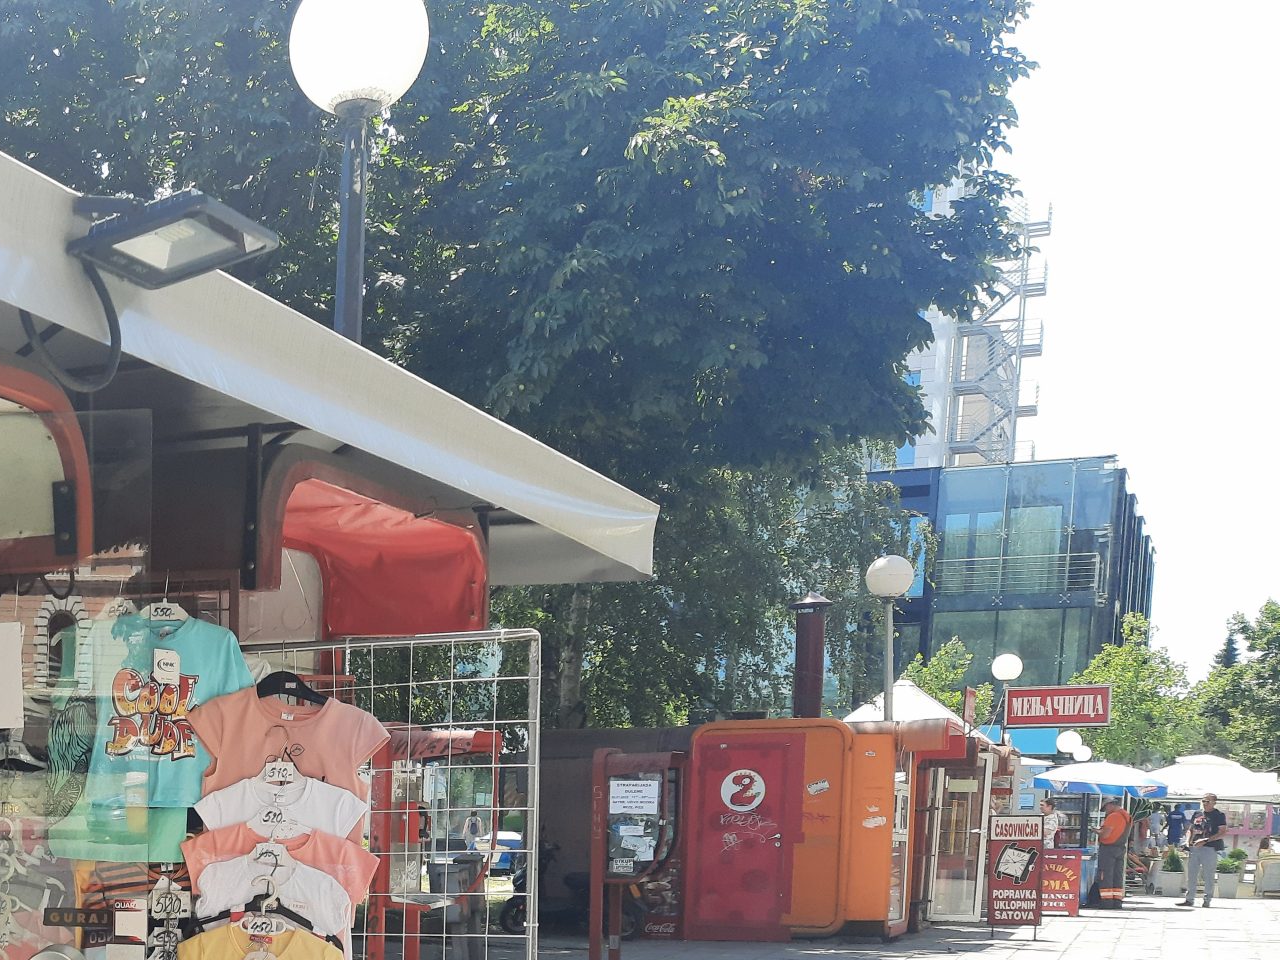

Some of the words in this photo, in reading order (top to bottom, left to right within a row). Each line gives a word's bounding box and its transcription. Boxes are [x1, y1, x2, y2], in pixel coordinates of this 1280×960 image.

[1010, 694, 1105, 718] МЕЊАЧНИЦА
[105, 712, 197, 762] DUDE
[994, 820, 1039, 838] ČASOVNIČAR
[992, 889, 1037, 899] POPRAVKA
[993, 900, 1036, 910] UKLOPNIH
[49, 912, 108, 924] GURAJ
[994, 910, 1035, 920] SATOVA
